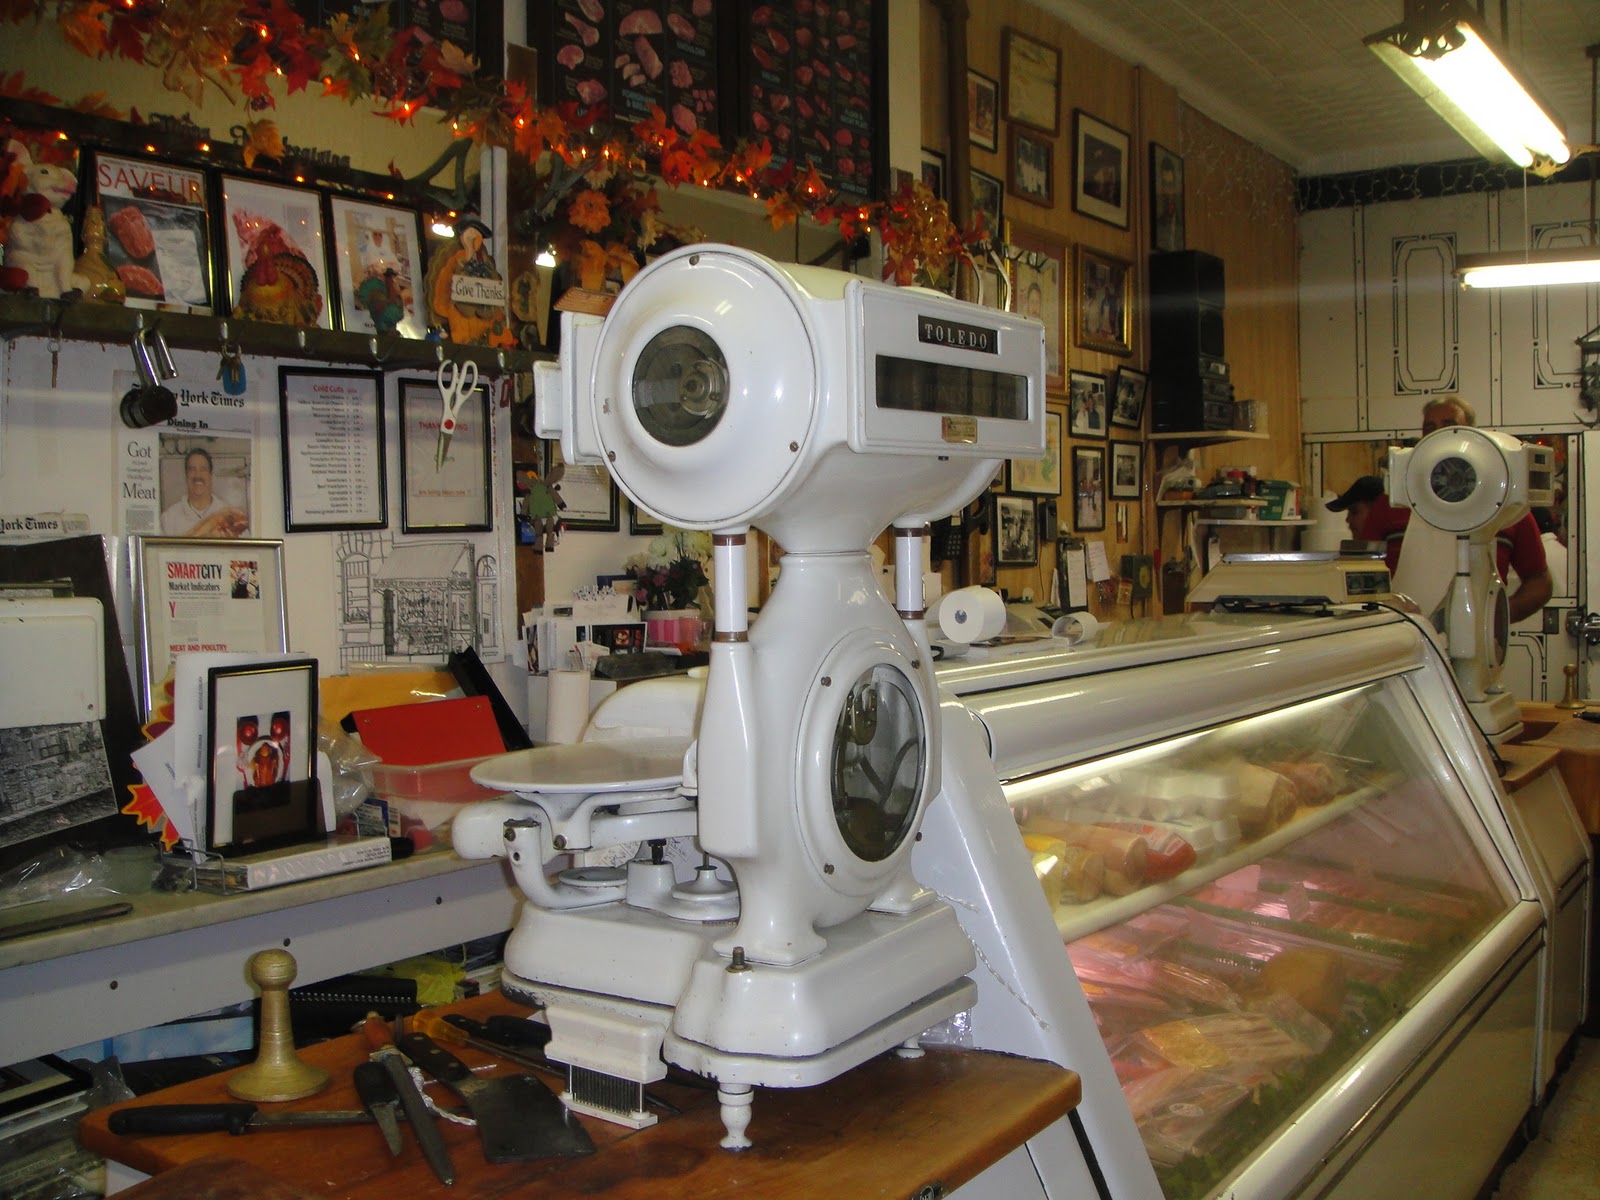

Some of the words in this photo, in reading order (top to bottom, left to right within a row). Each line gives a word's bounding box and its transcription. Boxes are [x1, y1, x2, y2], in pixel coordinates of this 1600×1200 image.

[98, 163, 204, 205] SAVEUR
[455, 278, 474, 298] Give
[475, 282, 503, 300] Thanks
[924, 323, 987, 350] TOLEDO
[180, 389, 208, 407] York
[210, 391, 245, 408] Times
[167, 418, 197, 429] Dining
[199, 420, 209, 429] In
[127, 441, 152, 459] Got
[123, 482, 156, 500] Meat
[25, 517, 59, 531] Times
[167, 563, 223, 580] SMARTCITY
[168, 582, 190, 592] Market
[191, 582, 220, 592] Indicators
[169, 644, 186, 652] MEAT
[187, 644, 200, 652] AND
[201, 644, 227, 652] POULTRY
